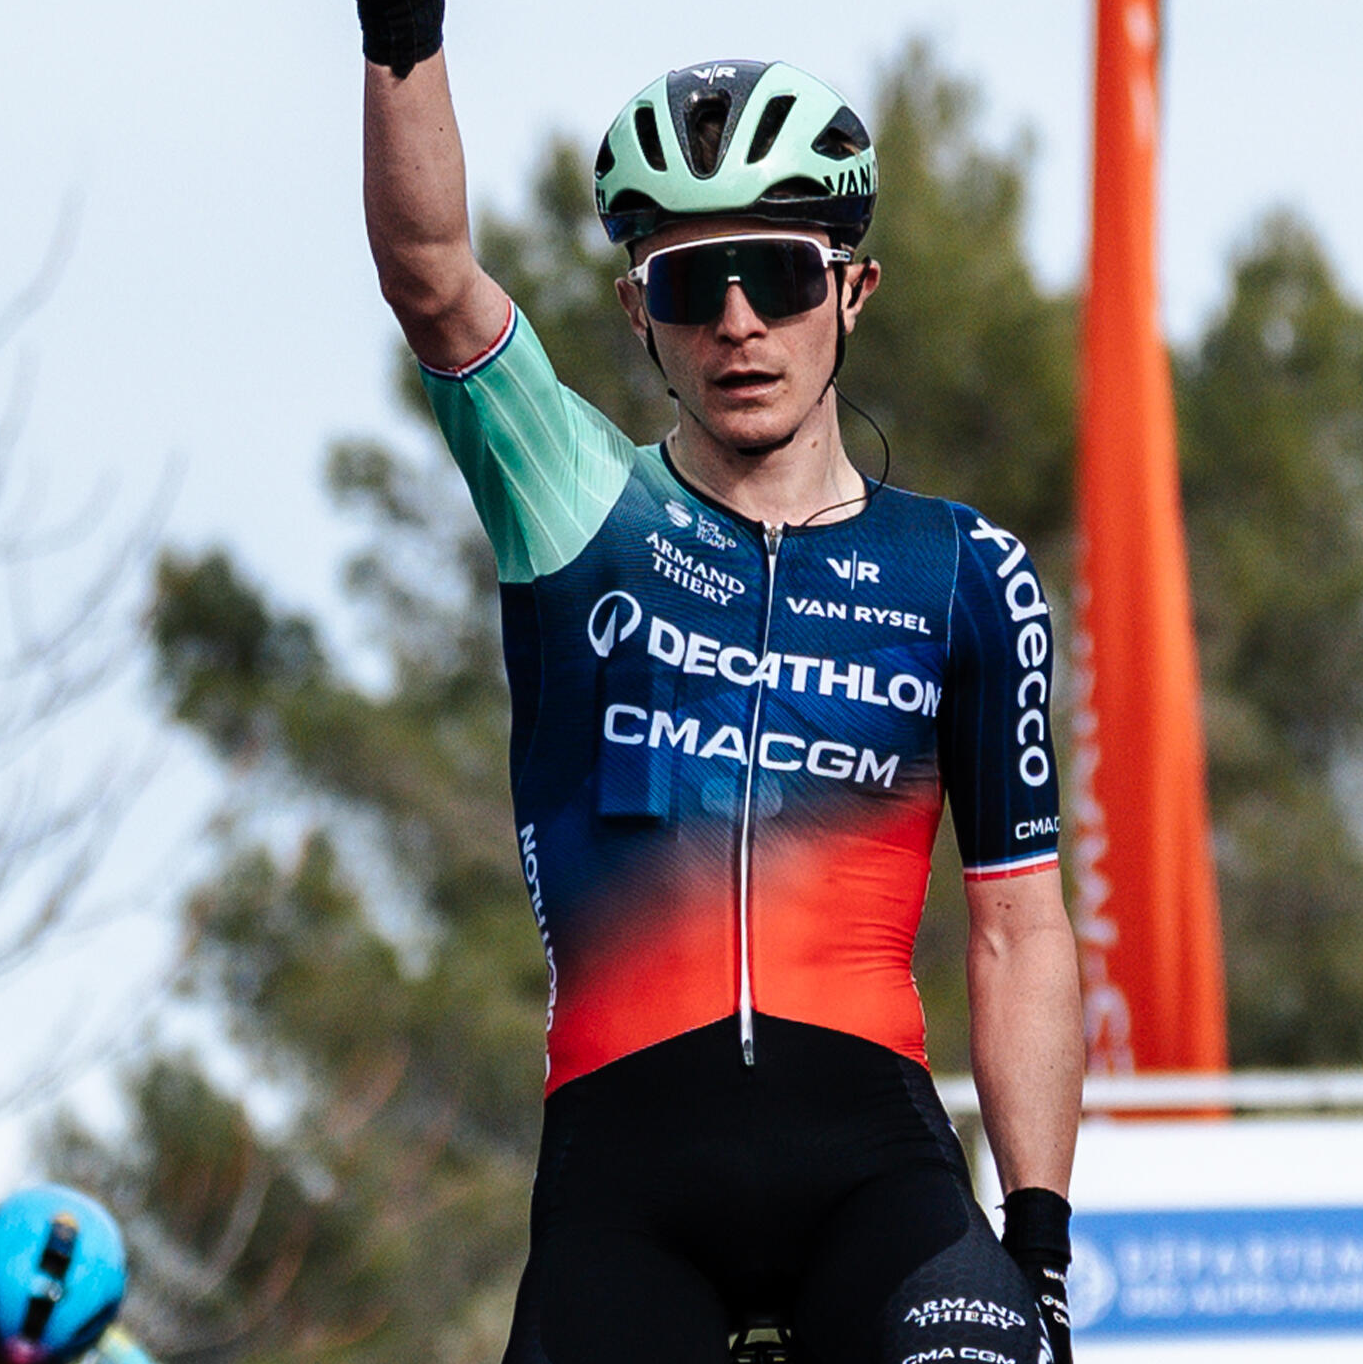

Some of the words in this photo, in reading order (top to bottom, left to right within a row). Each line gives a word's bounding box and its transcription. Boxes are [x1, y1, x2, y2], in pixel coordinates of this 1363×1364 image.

[823, 163, 871, 196] VAN
[645, 531, 746, 595] ARMAND
[652, 552, 733, 607] THIERY
[786, 596, 847, 620] VAN
[854, 605, 932, 635] RYSEL
[647, 616, 943, 718] DECATHLON
[604, 703, 748, 766] CMA
[758, 732, 901, 788] CGM
[903, 1297, 1026, 1326] ARMAND
[914, 1310, 1014, 1330] THIERY
